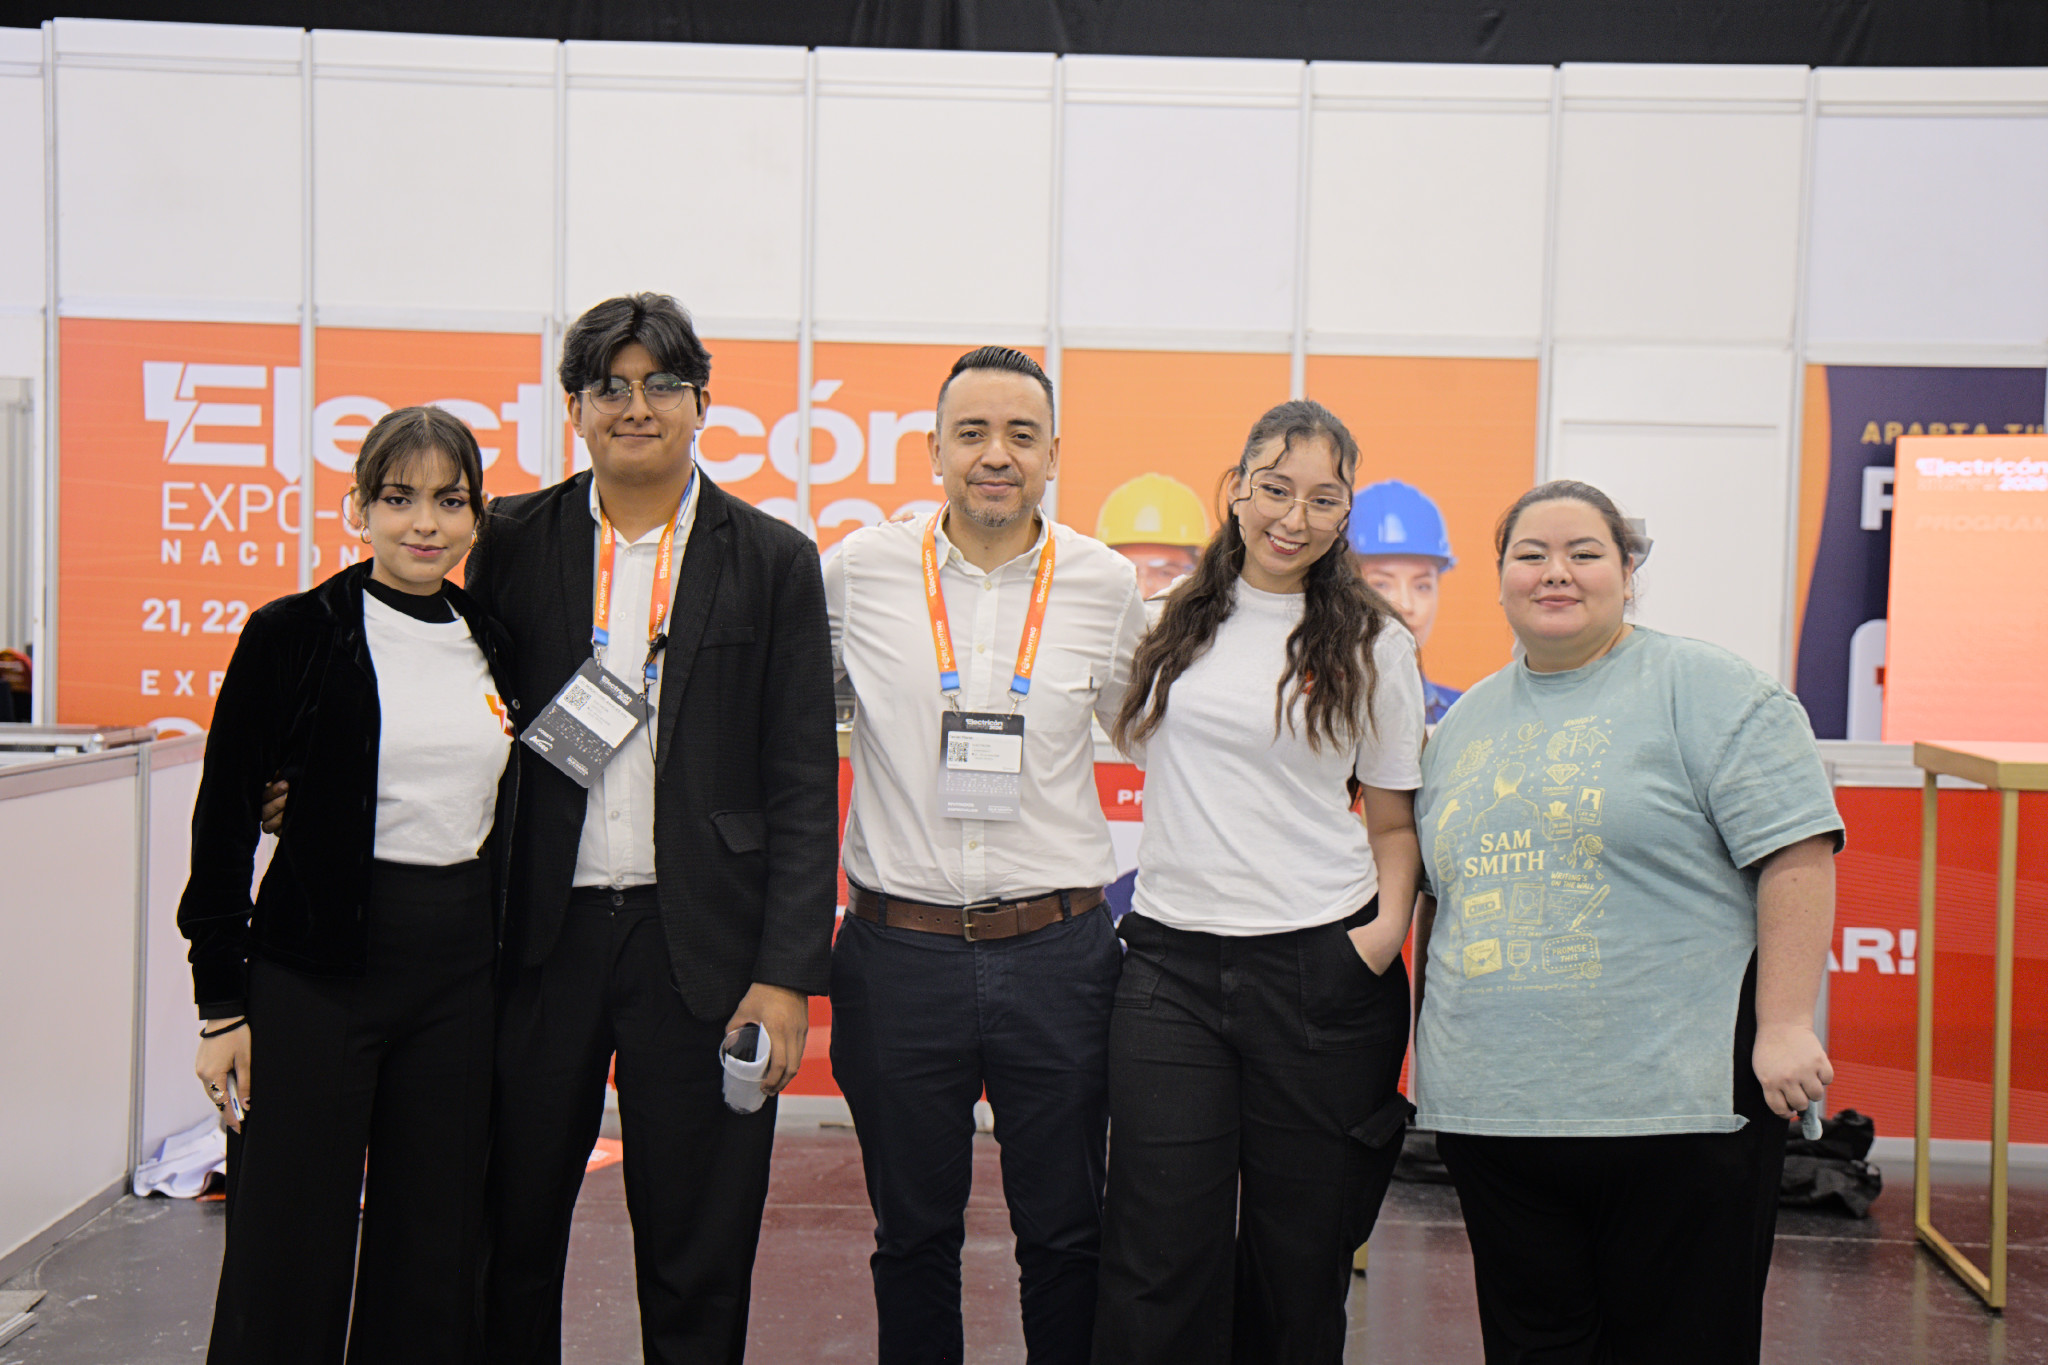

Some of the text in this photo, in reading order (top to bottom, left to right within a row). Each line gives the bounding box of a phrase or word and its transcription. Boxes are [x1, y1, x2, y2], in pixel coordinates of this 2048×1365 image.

[143, 360, 944, 486] Eletcón
[142, 598, 249, 637] 21, 22
[1480, 828, 1532, 853] SAM
[1464, 850, 1545, 878] SMITH
[1551, 871, 1588, 882] WRITING'S
[1563, 880, 1577, 888] THE
[1576, 882, 1595, 890] WALL
[1552, 943, 1588, 955] PROMISE
[1560, 953, 1579, 962] THIS
